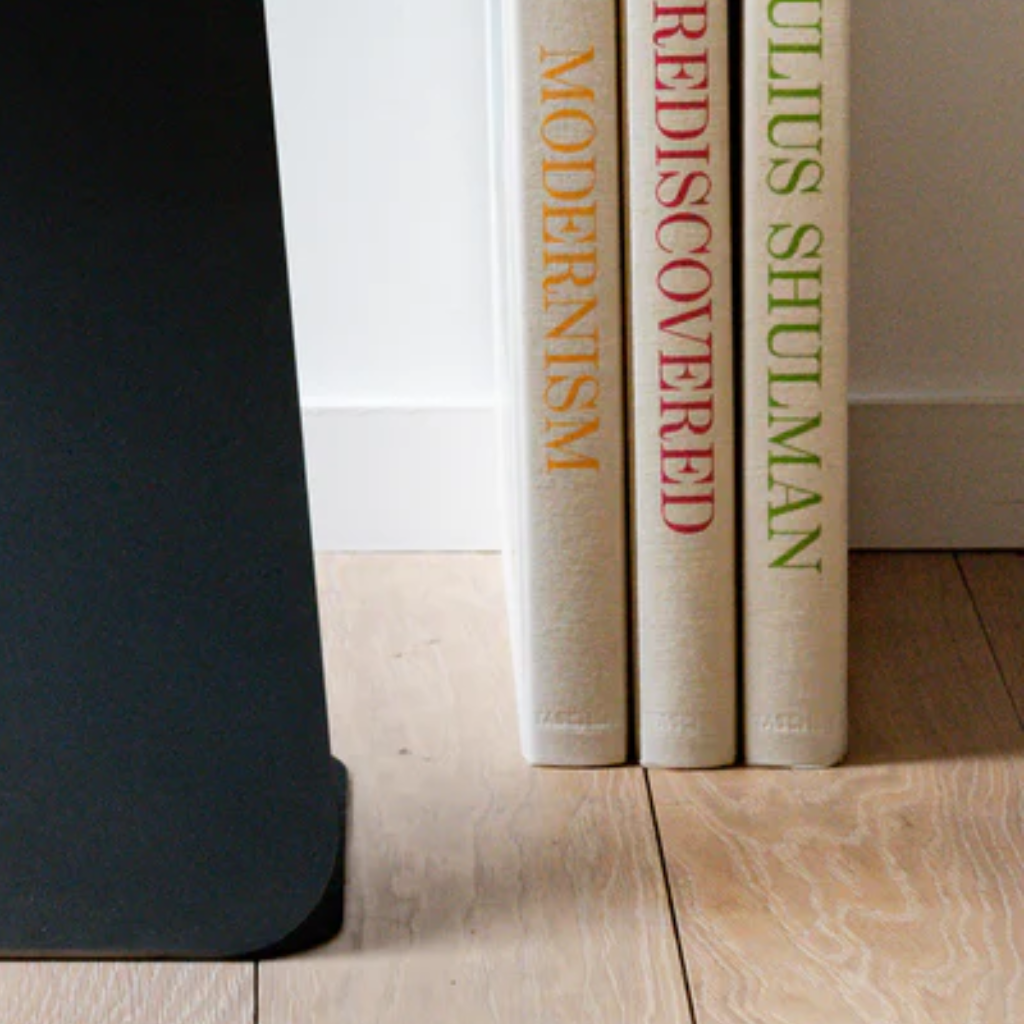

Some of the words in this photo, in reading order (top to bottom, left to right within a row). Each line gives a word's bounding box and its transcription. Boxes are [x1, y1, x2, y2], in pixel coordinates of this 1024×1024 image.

[539, 44, 600, 473] MODERNISM
[652, 0, 716, 535] REDISCOVERED
[767, 223, 824, 573] SHULMAN
